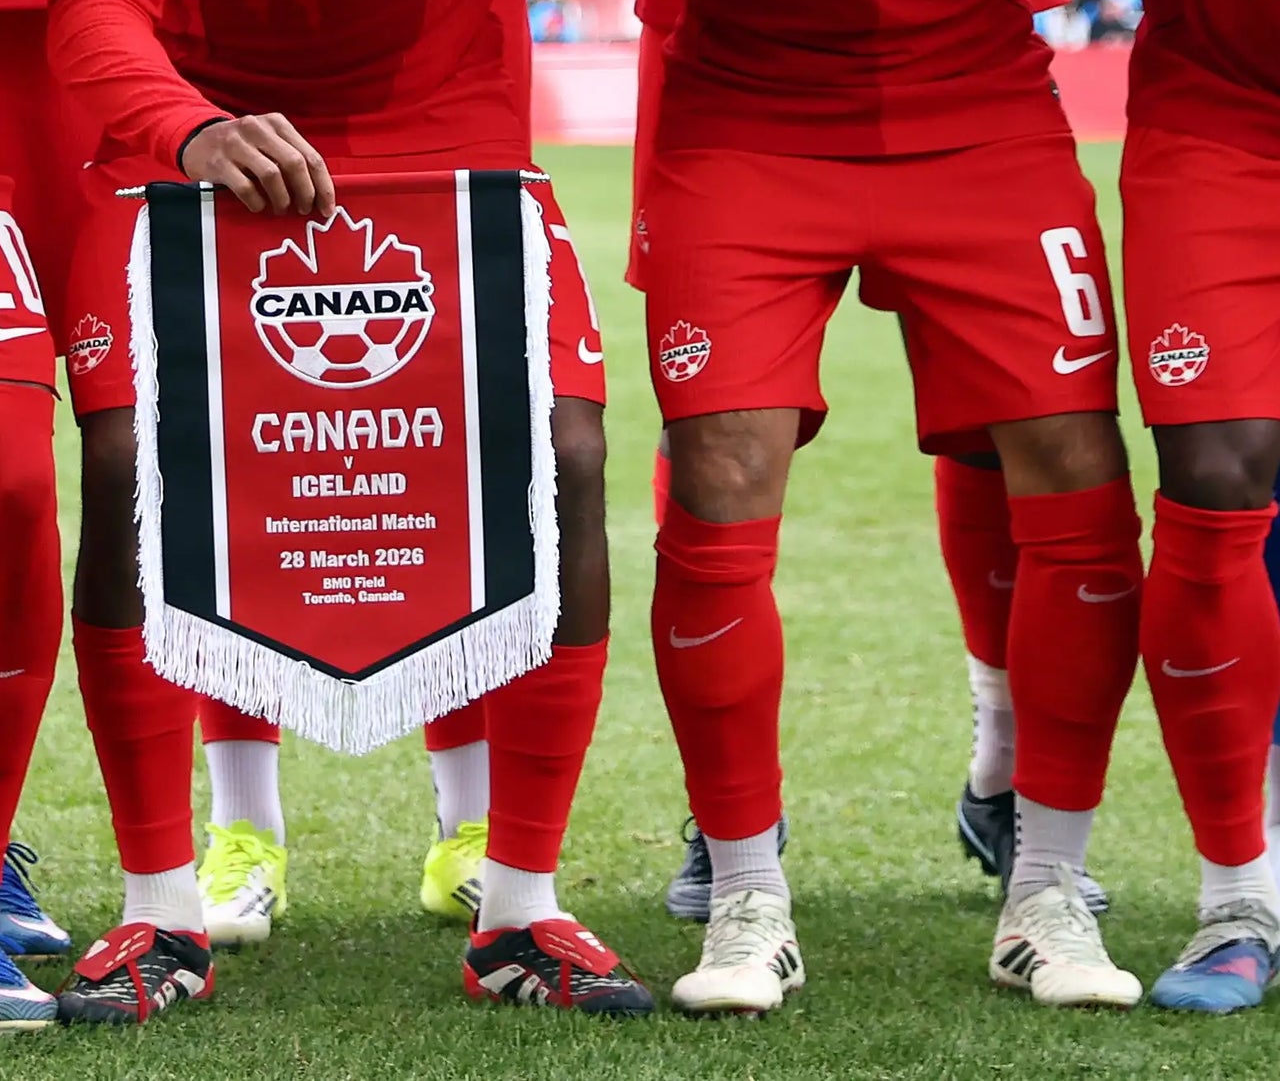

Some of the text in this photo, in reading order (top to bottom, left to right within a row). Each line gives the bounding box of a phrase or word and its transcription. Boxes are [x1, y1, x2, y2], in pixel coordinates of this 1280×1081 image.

[1040, 227, 1106, 337] 6
[660, 344, 709, 363] CANADA
[1151, 349, 1207, 364] CANADA
[251, 407, 444, 453] CANADA
[292, 472, 407, 497] ICELAND
[265, 512, 437, 533] International Match
[280, 547, 425, 569] 28 March 2026
[323, 575, 385, 589] BMO Field
[302, 590, 405, 605] Toronto, Canada
